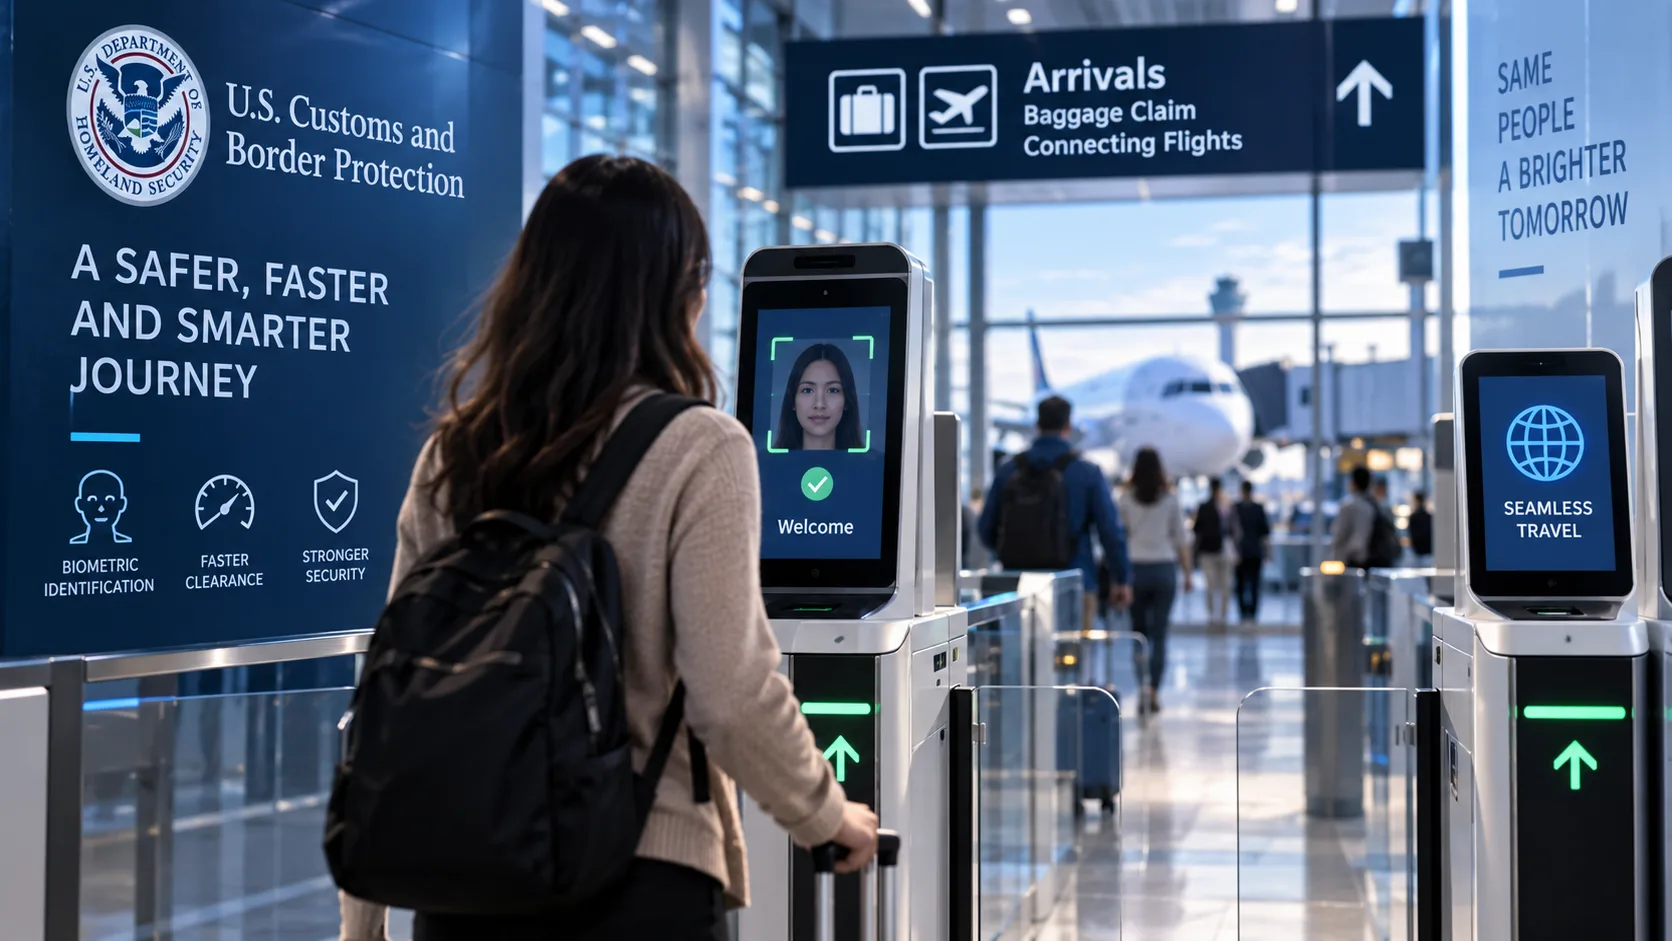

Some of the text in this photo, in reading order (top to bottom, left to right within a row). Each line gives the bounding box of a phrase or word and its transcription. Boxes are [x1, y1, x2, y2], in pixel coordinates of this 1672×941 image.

[77, 64, 98, 93] U.S.
[102, 35, 192, 83] DEPARTMENT
[1023, 55, 1166, 94] Arrivals
[1498, 50, 1553, 95] SAME
[225, 82, 456, 154] U.S. Customs and
[1024, 98, 1196, 130] Baggage Claim
[1498, 96, 1575, 144] PEOPLE
[76, 116, 202, 195] HOMELAND SECURITY
[1023, 129, 1243, 158] Connecting Flights
[225, 130, 465, 199] Border Protection
[1497, 139, 1627, 194] A BRIGHTER
[1498, 190, 1629, 242] TOMORROW
[70, 243, 389, 306] A SAFER, FASTER
[70, 300, 351, 353] AND SMARTER
[70, 356, 258, 399] JOURNEY
[777, 518, 854, 535] Welcome
[1504, 500, 1593, 516] SEAMLESS
[1516, 523, 1582, 538] TRAVEL
[62, 557, 139, 575] BIOMETRIC
[201, 553, 249, 568] FASTER
[302, 547, 369, 564] STRONGER
[305, 567, 366, 583] SECURITY
[44, 578, 154, 597] IDENTIFICATION
[185, 572, 264, 590] CLEARANCE
